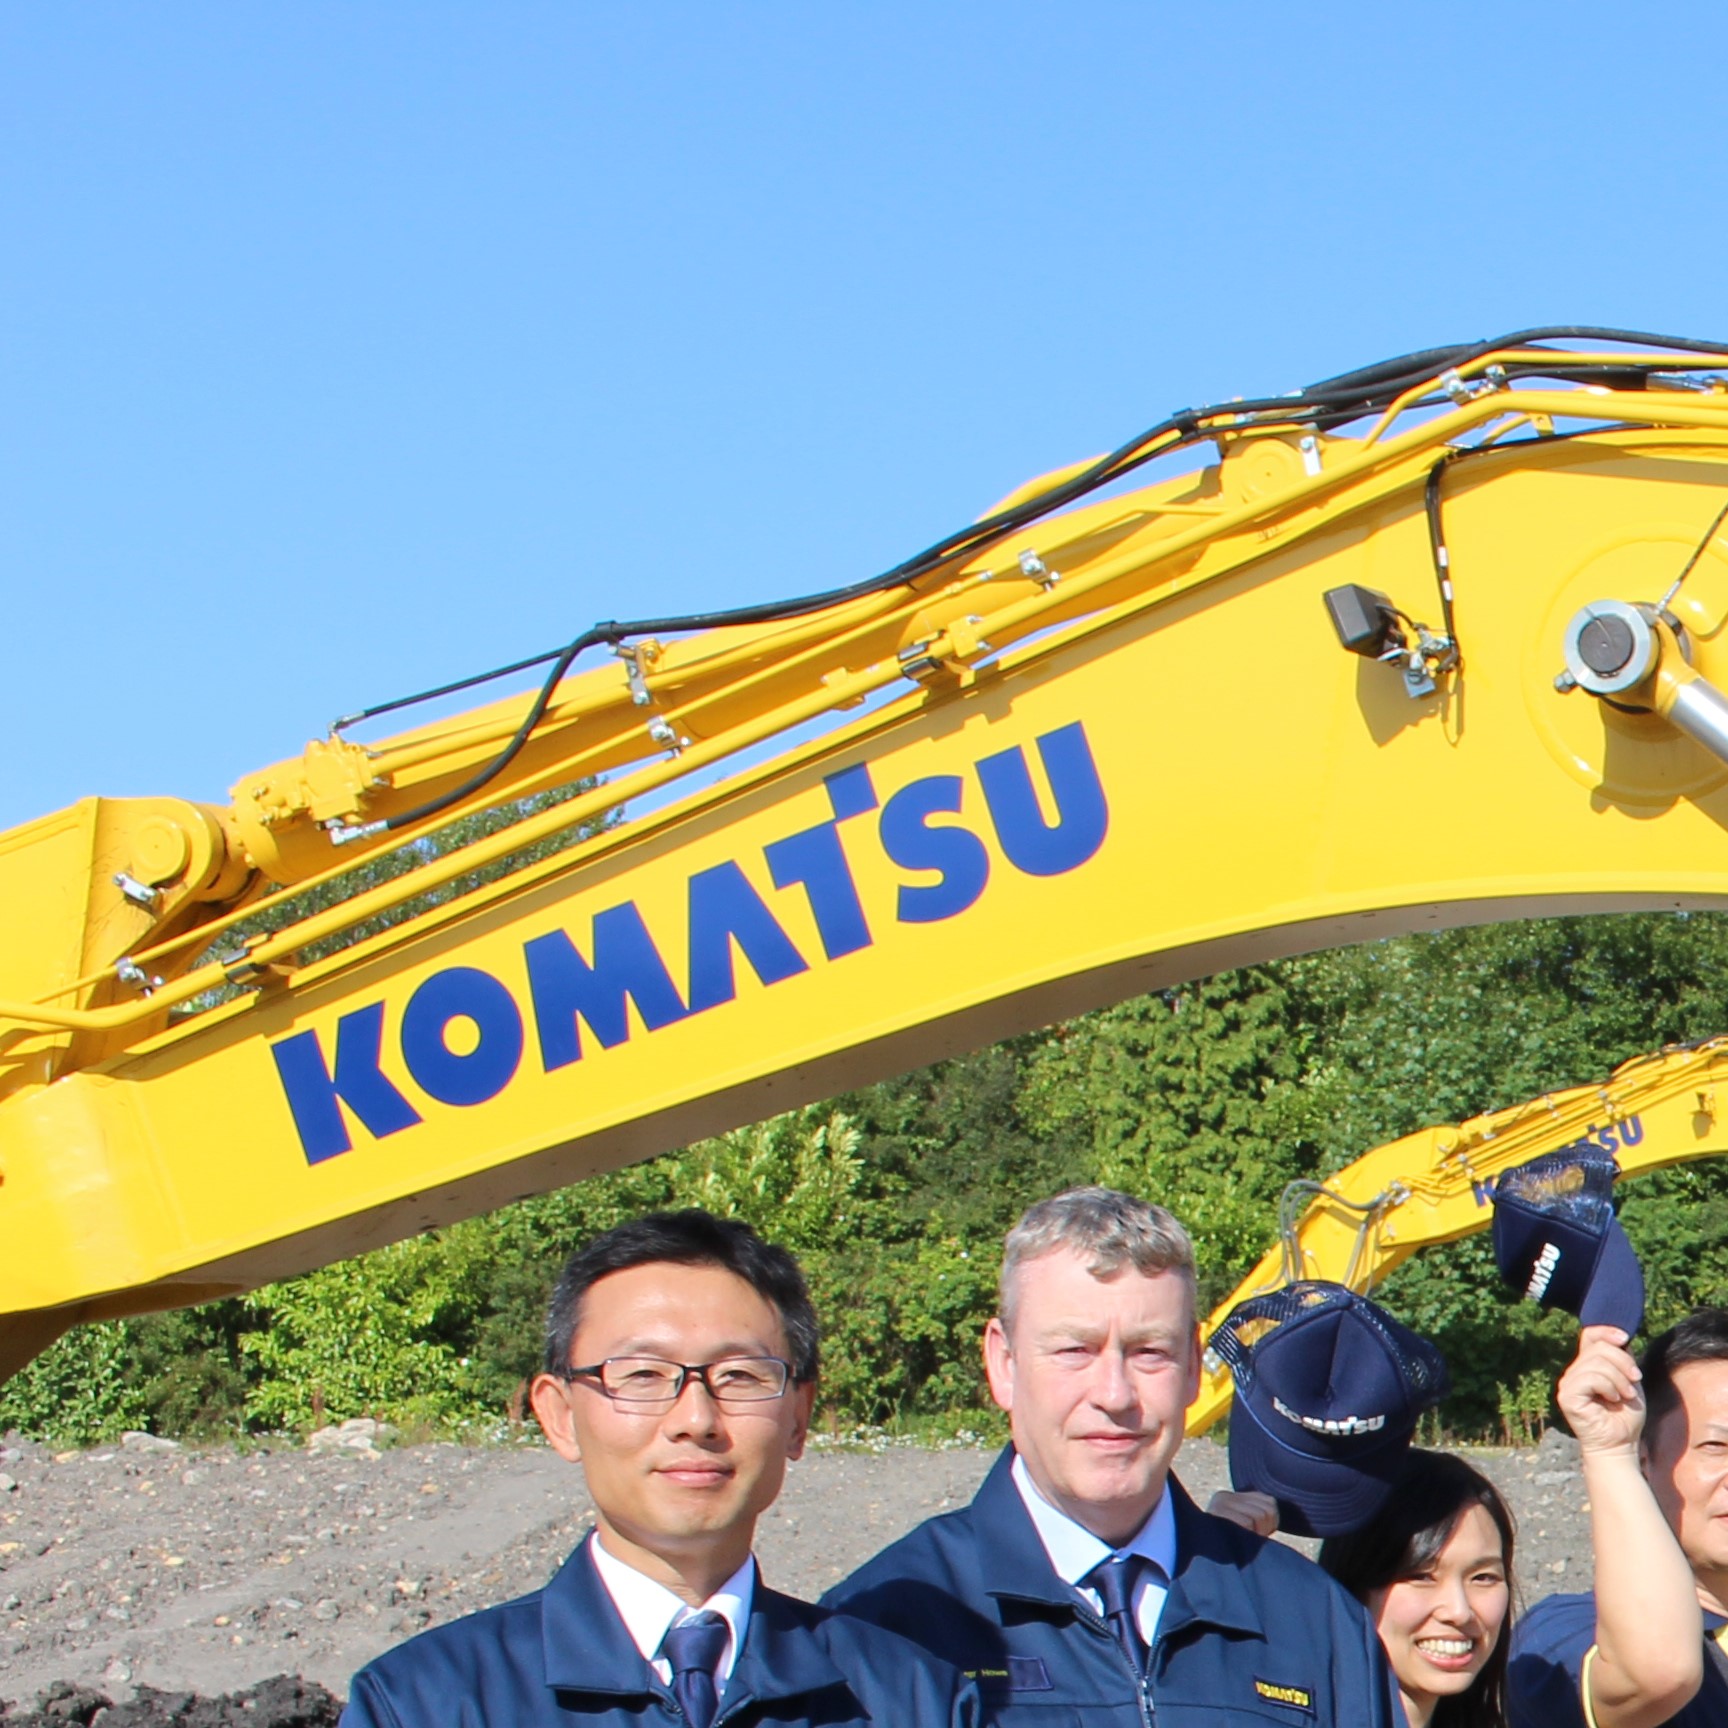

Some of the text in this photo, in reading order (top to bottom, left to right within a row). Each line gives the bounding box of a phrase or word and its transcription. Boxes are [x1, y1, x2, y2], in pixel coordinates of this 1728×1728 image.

[271, 720, 1110, 1167] KOMATSU
[1524, 1242, 1561, 1302] MATSU
[1273, 1396, 1385, 1436] KOMATSU
[1255, 1681, 1309, 1706] KOMATSU
